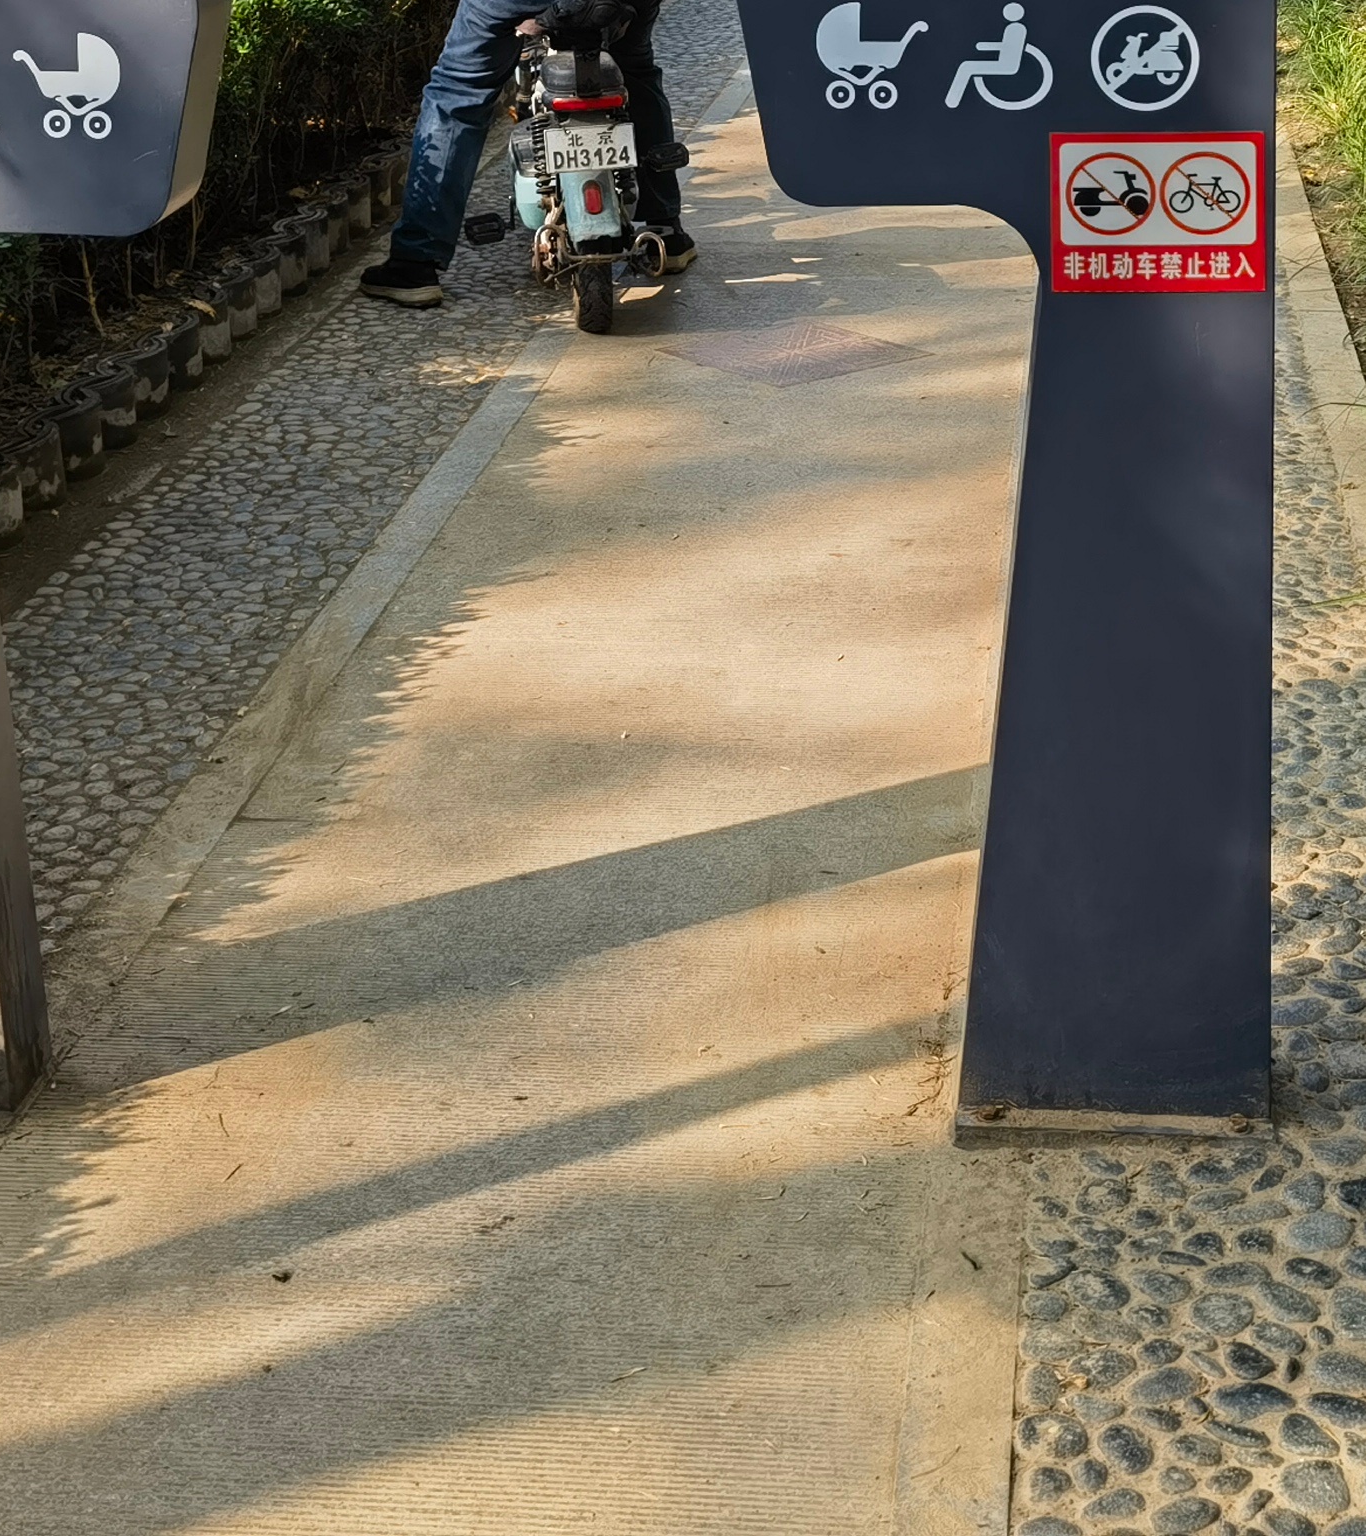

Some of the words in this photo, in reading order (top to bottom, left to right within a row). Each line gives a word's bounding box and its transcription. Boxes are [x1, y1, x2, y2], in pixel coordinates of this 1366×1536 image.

[567, 131, 614, 147] 北京
[553, 146, 630, 170] DH3124
[1063, 251, 1256, 280] 非机动车禁止进入
